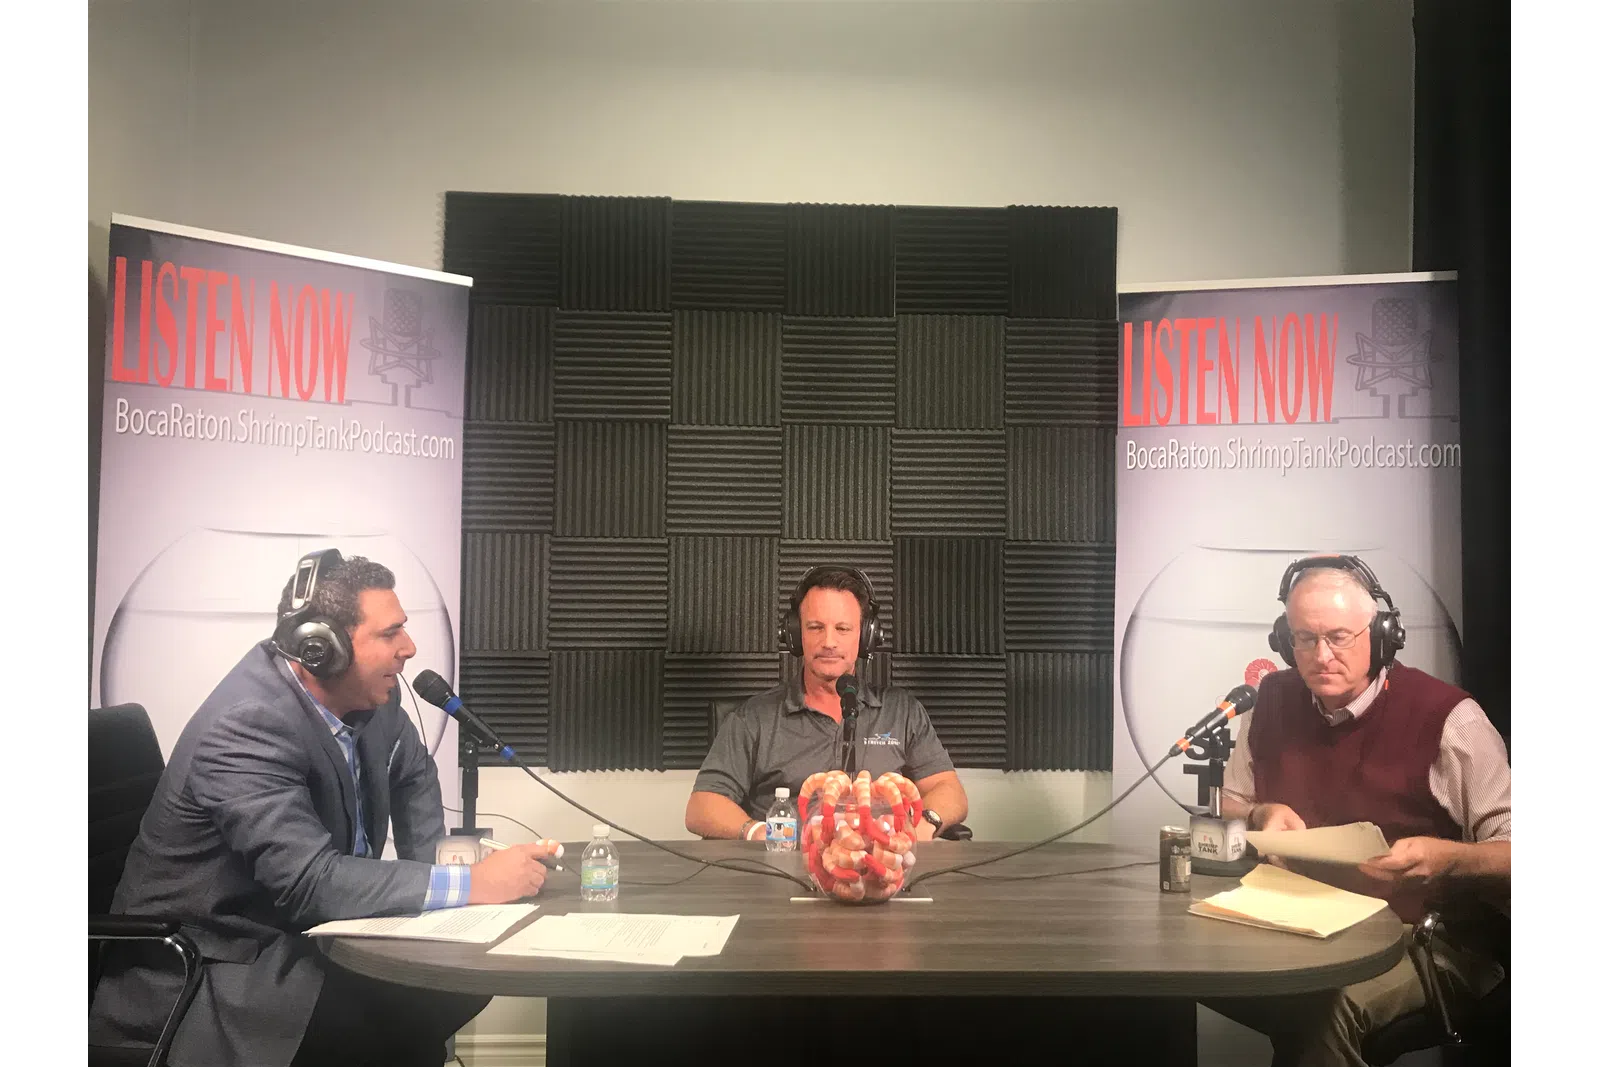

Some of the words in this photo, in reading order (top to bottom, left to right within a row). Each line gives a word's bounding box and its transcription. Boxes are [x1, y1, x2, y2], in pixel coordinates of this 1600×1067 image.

[112, 256, 255, 394] LISTEN
[268, 279, 356, 404] NOW
[1123, 316, 1240, 427] LISTEN
[1254, 312, 1339, 424] NOW
[115, 397, 455, 459] BocaRaton.ShrimpTankPodcast.com
[1126, 436, 1462, 476] BocaRaton.ShrimpTankPodcast.com
[1198, 846, 1219, 855] TANK
